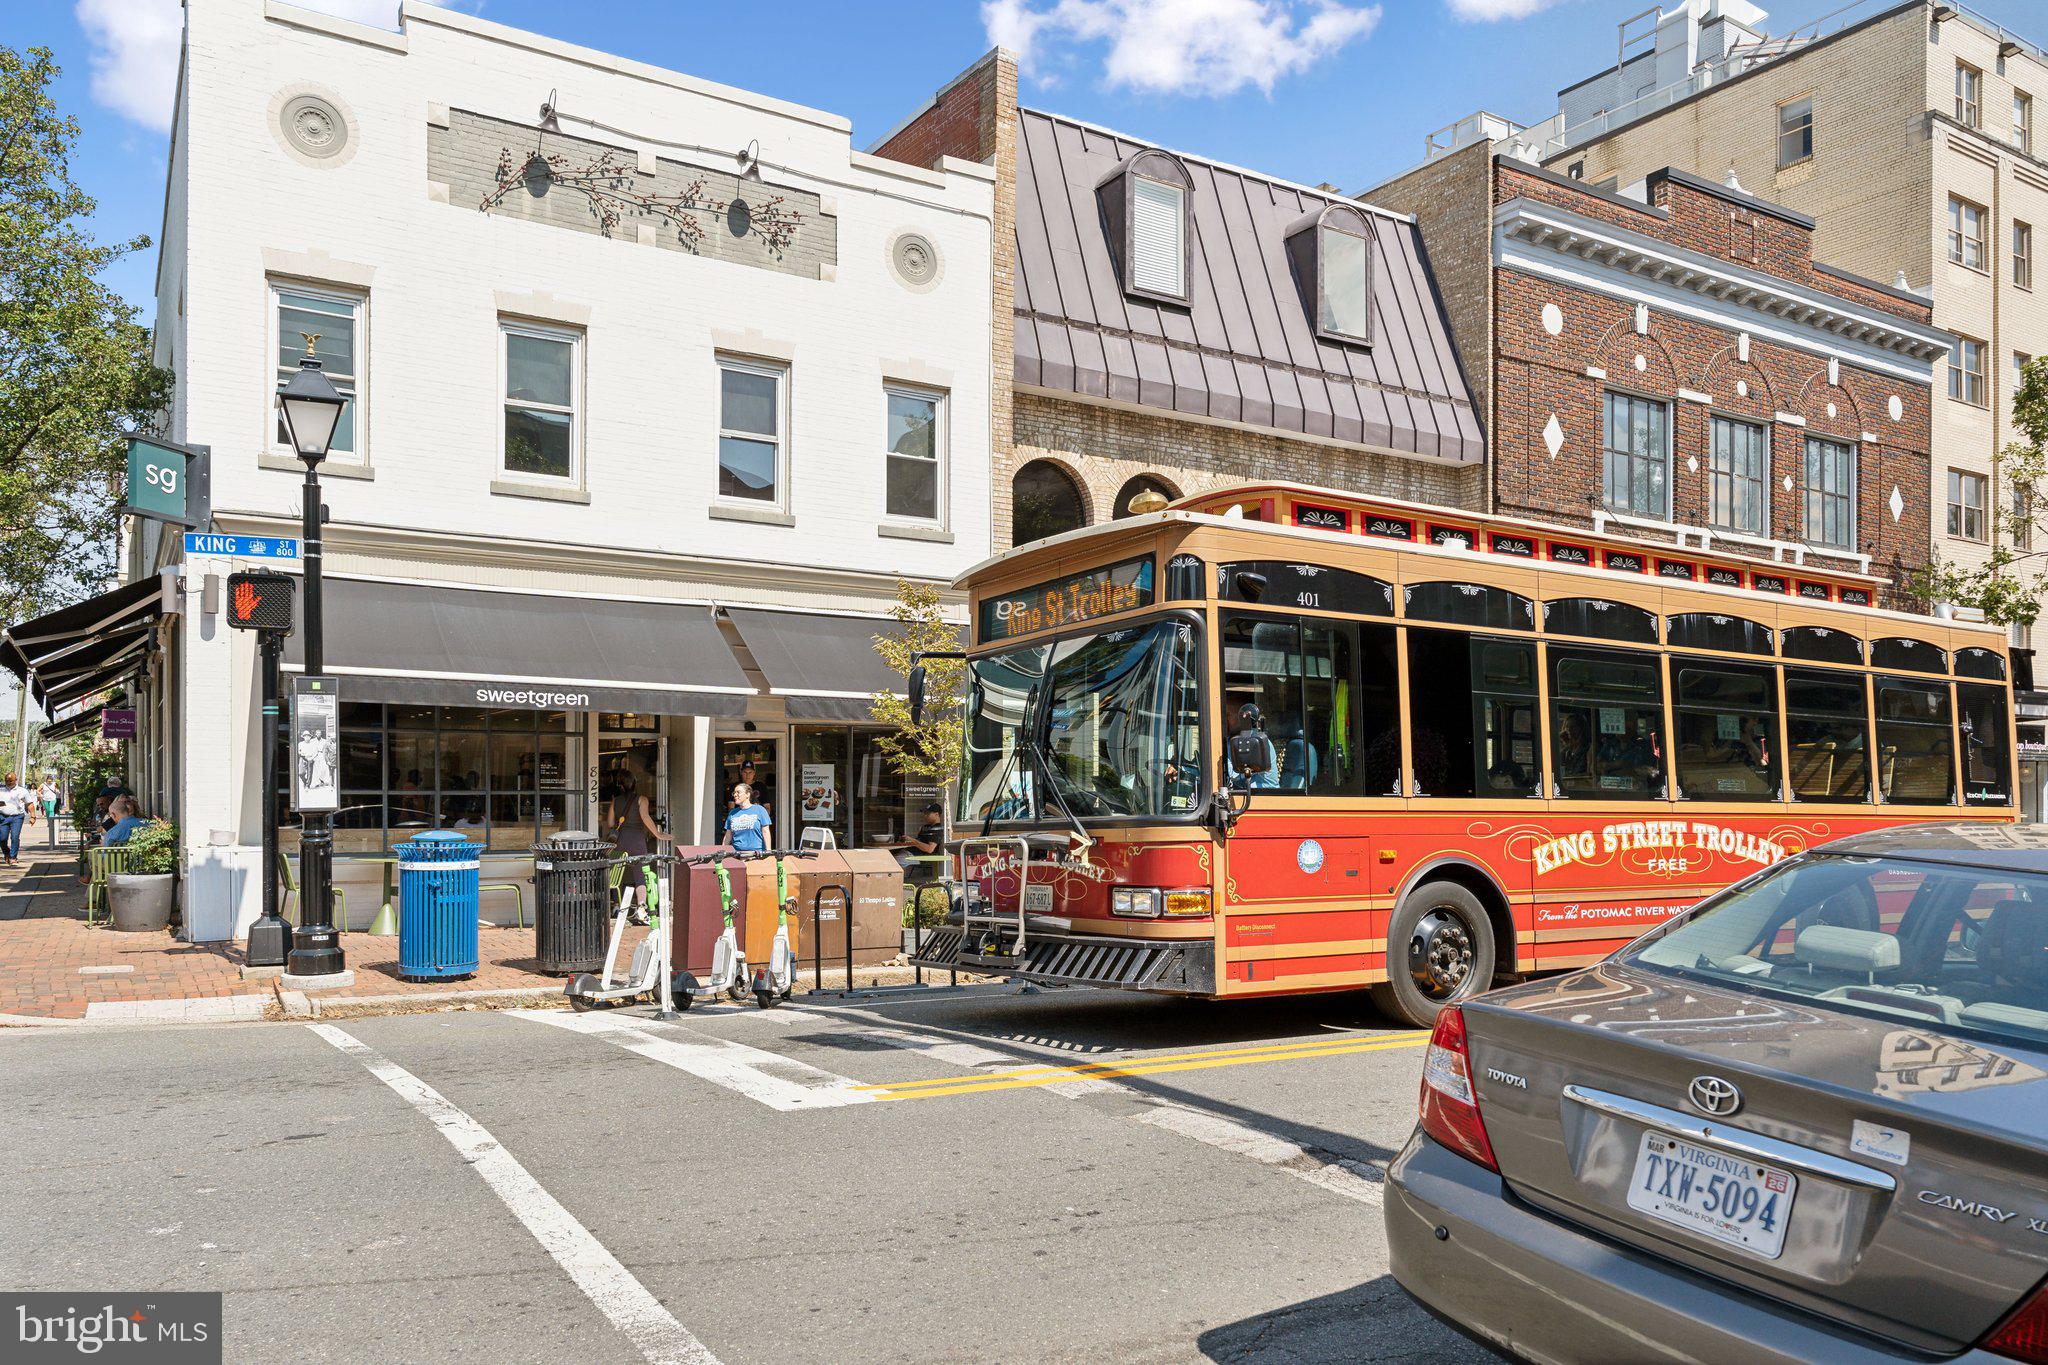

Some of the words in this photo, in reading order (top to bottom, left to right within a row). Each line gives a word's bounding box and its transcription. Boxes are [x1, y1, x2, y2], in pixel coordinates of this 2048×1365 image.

[145, 461, 178, 494] sg
[194, 536, 236, 553] KING
[276, 547, 294, 557] 800
[279, 540, 290, 549] ST
[1045, 591, 1064, 627] St
[1069, 579, 1137, 621] Trolley
[1297, 591, 1320, 608] 401
[476, 688, 589, 708] sweetgreen
[1532, 830, 1597, 876] KING
[1603, 820, 1688, 852] STREET
[1692, 821, 1787, 866] TROLLEY
[1648, 858, 1688, 872] FREE
[1538, 908, 1564, 922] From
[1563, 904, 1579, 920] the
[1580, 907, 1633, 919] POTOMAC
[1635, 905, 1665, 917] RIVER
[1666, 905, 1692, 915] WAT
[1487, 1067, 1528, 1089] TOYOTA
[1647, 1140, 1665, 1153] MAR
[1679, 1145, 1751, 1181] VIRGINIA
[1643, 1153, 1779, 1233] TXW-5094
[1769, 1179, 1786, 1192] 26
[1664, 1201, 1693, 1217] VIRGINIA
[1694, 1212, 1700, 1220] IS
[1701, 1212, 1716, 1225] FOR
[1917, 1190, 2019, 1224] CAMRY
